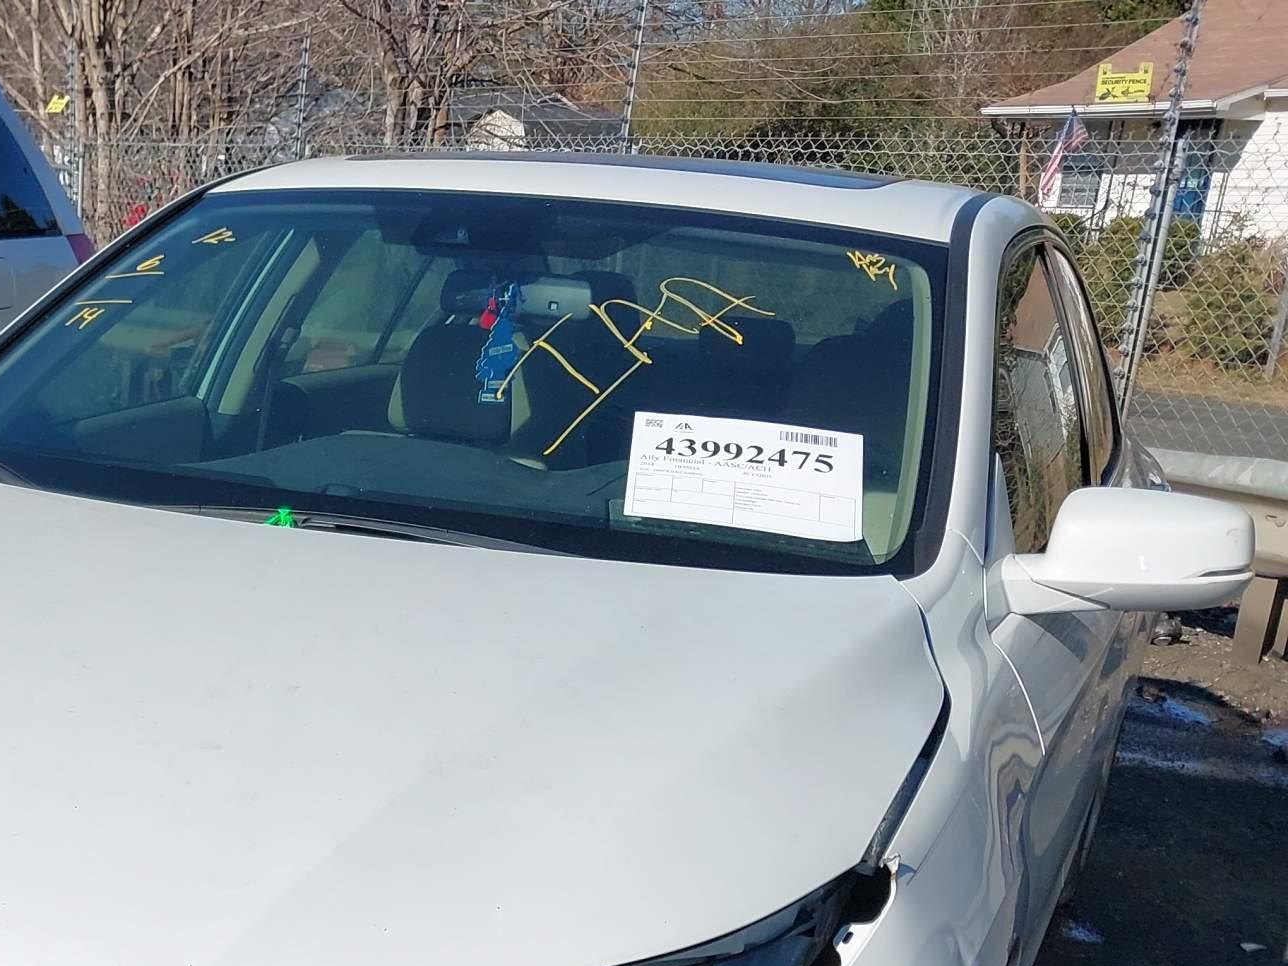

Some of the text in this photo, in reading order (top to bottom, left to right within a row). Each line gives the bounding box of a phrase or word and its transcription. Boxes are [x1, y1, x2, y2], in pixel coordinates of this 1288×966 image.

[64, 307, 105, 329] 14
[640, 453, 660, 462] Ally
[663, 455, 705, 466] Financial
[655, 436, 835, 474] 43992475
